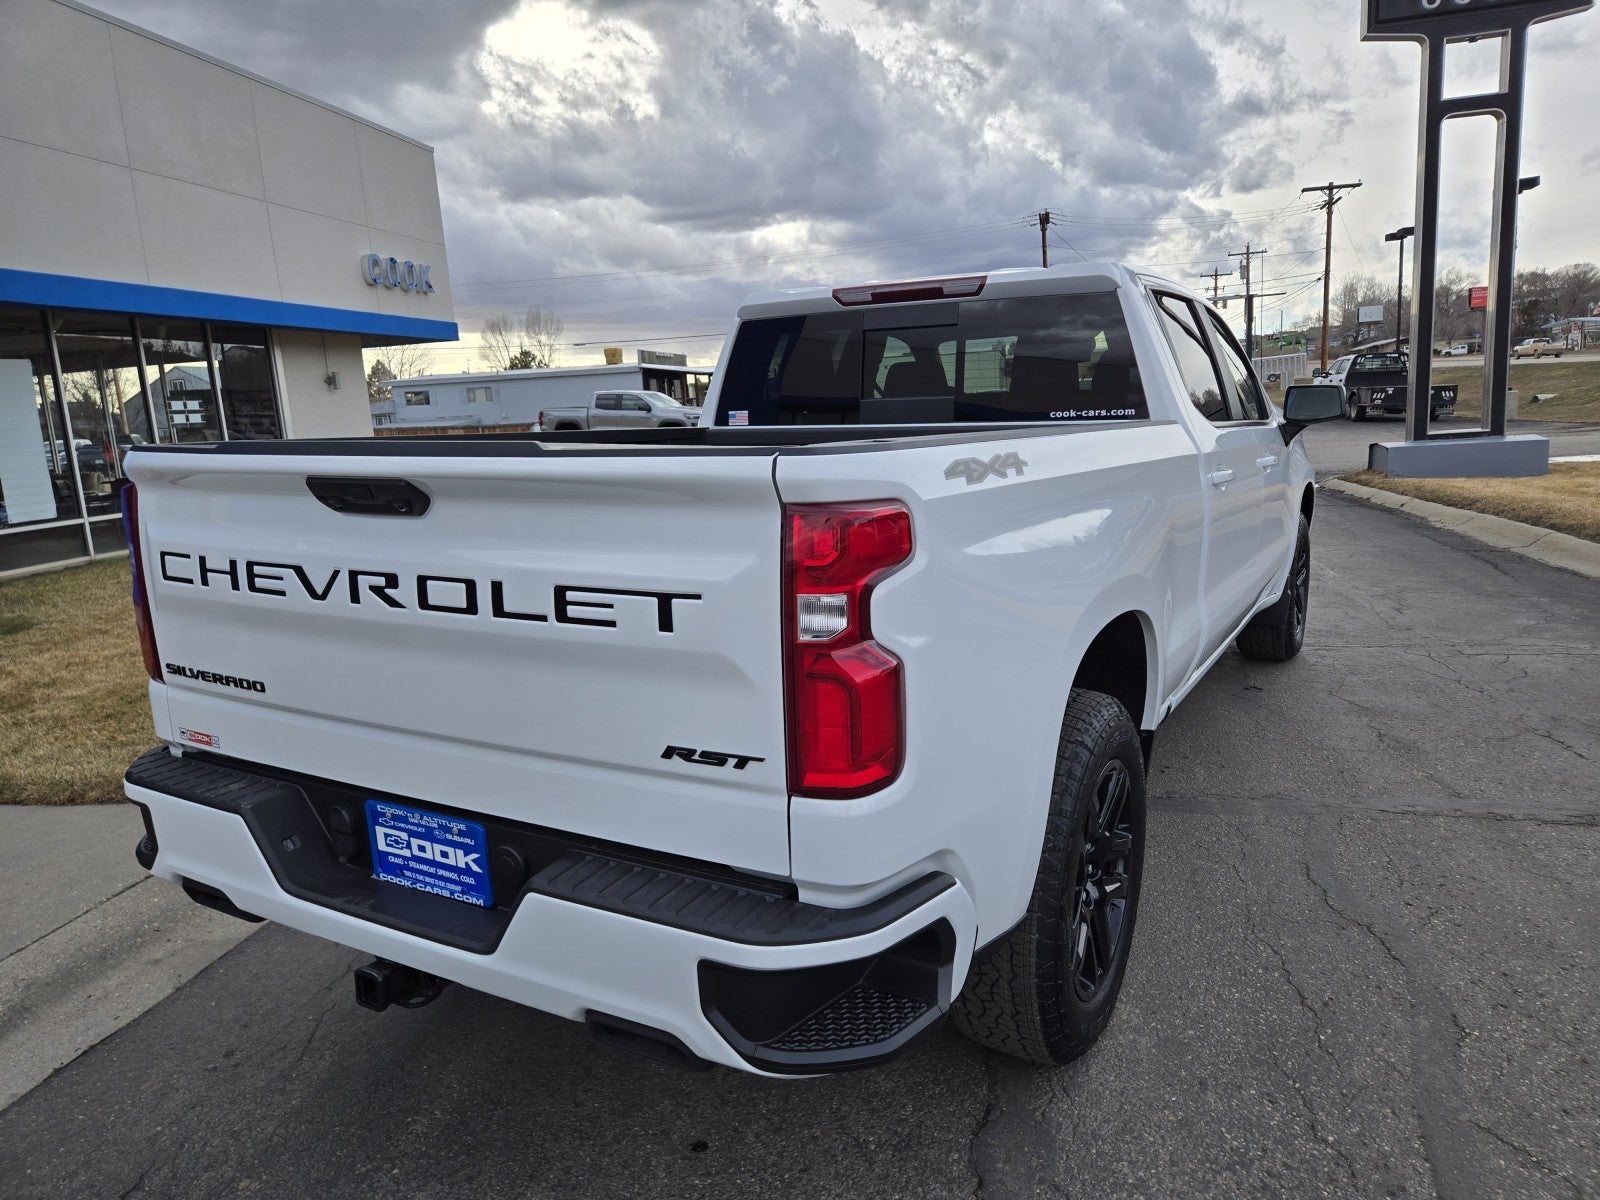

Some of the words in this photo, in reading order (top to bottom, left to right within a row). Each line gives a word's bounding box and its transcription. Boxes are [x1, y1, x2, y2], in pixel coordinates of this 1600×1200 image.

[361, 253, 435, 294] COOK
[1049, 408, 1136, 418] cook-cars.com
[159, 550, 703, 633] CHEVROLET
[165, 662, 266, 693] SILVERADO
[660, 744, 766, 771] RST
[422, 815, 467, 831] ALTITUDE
[375, 825, 484, 873] COOK
[445, 833, 475, 845] SUBARU
[380, 872, 485, 906] COOK-CARS.COM
